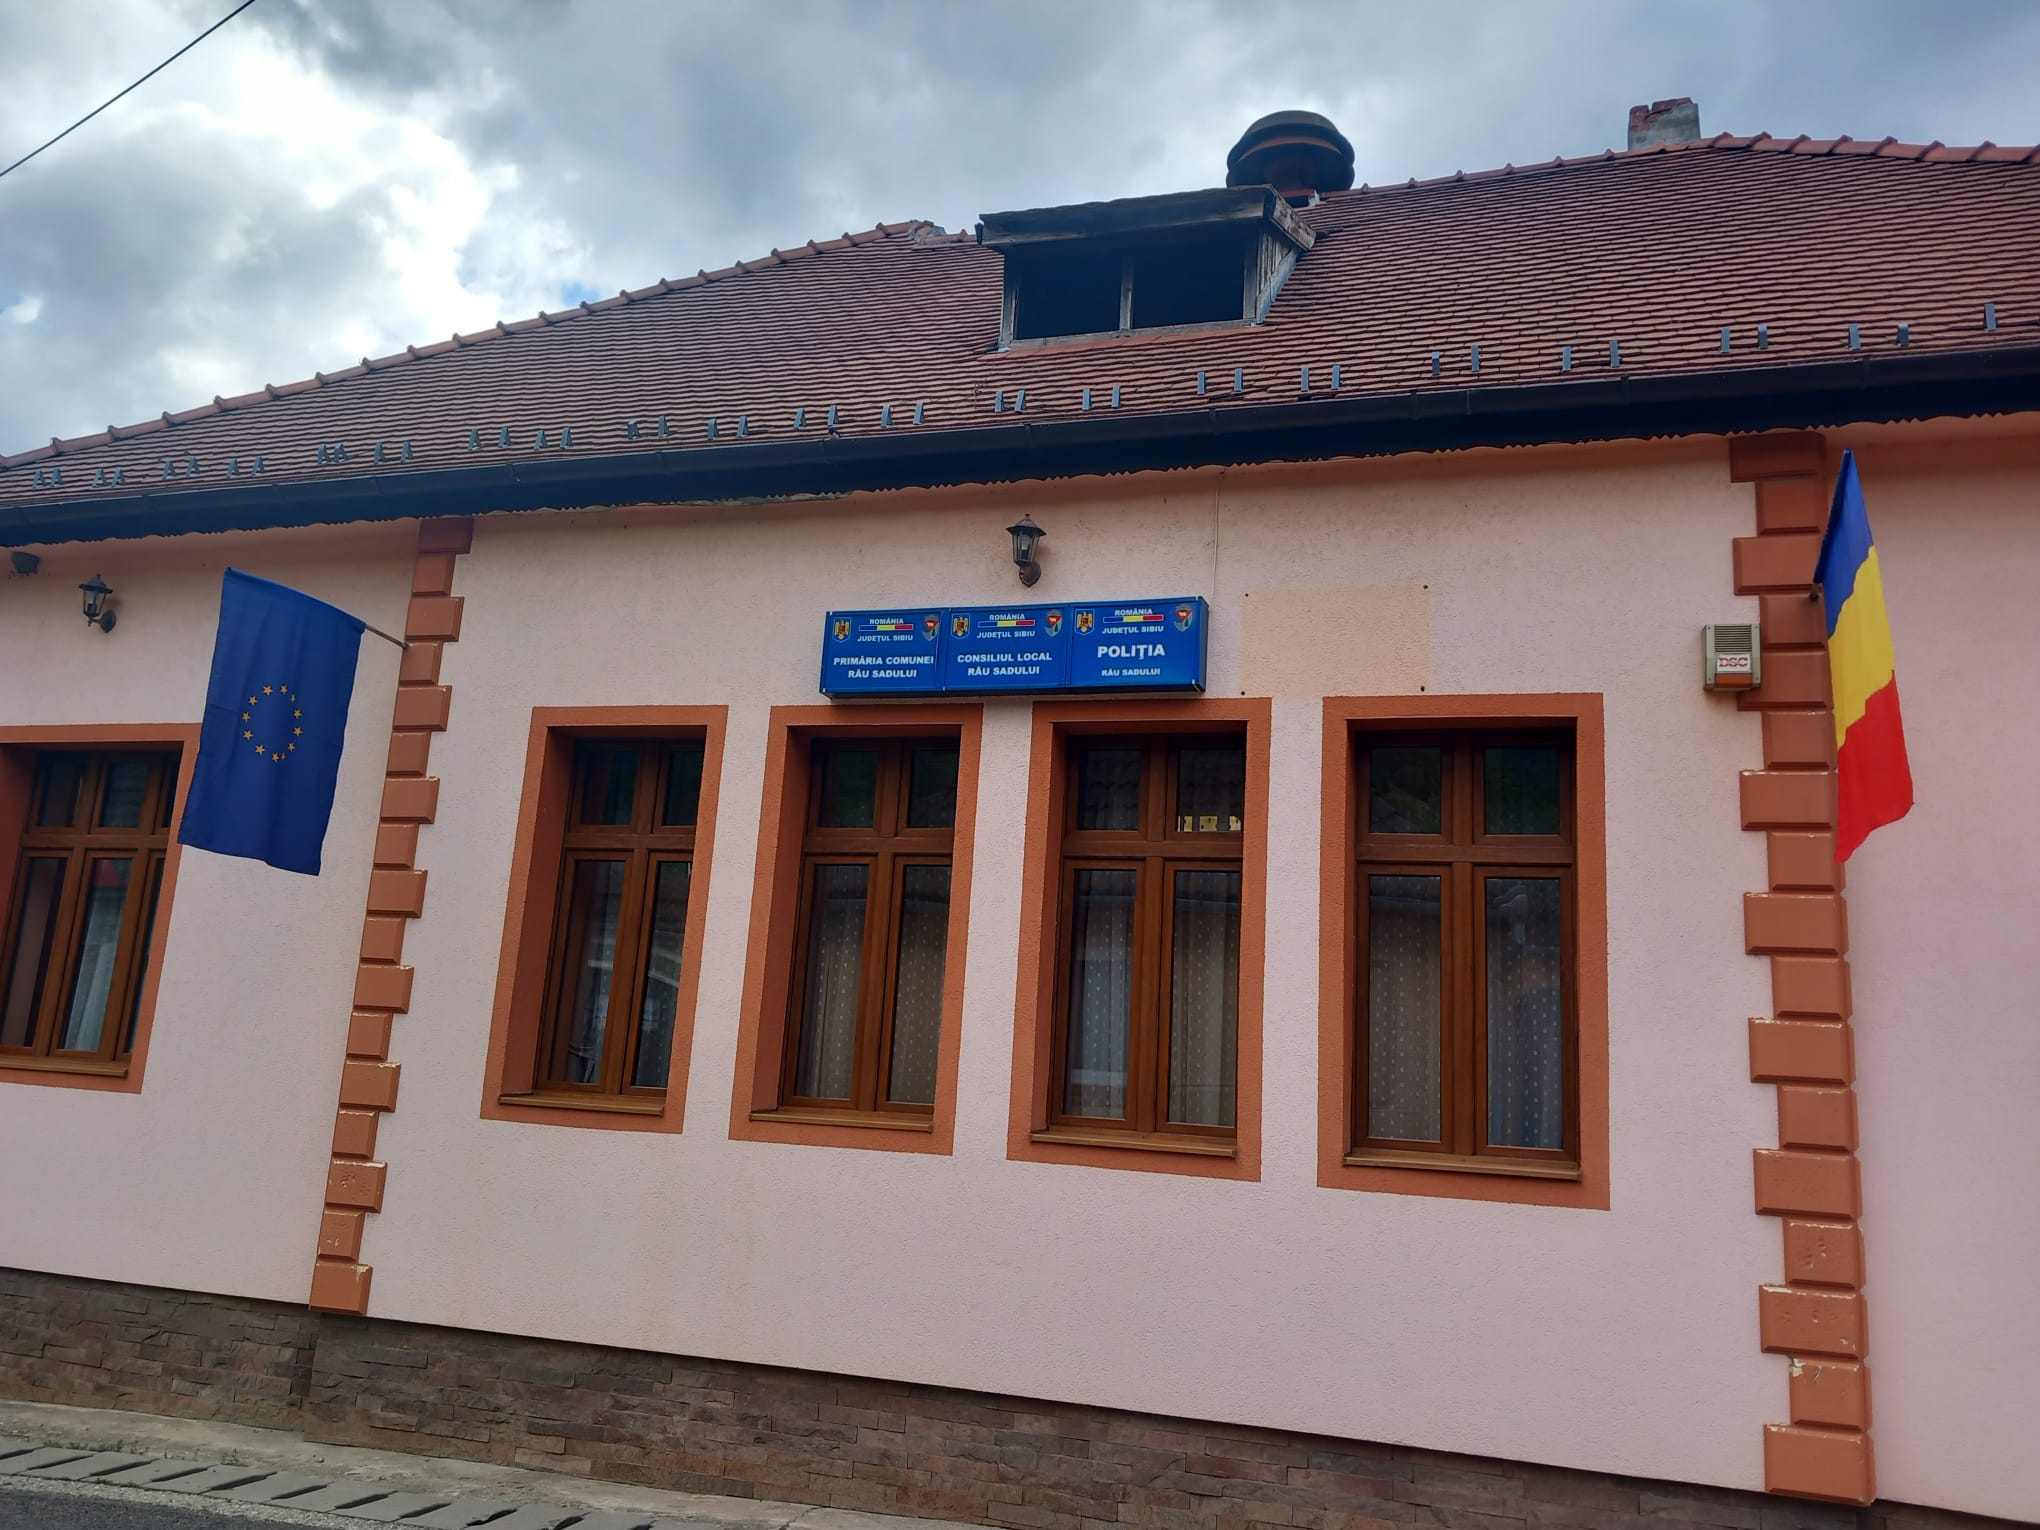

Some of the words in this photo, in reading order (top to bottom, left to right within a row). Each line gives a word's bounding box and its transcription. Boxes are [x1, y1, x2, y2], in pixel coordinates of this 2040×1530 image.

[1114, 608, 1153, 616] ROMÂNIA
[869, 617, 904, 625] ROMÂNIA
[989, 613, 1025, 621] ROMÂNIA
[1141, 625, 1164, 633] SIBIU
[1014, 630, 1035, 638] SIBIU
[833, 655, 883, 665] PRIMĂRIA
[885, 655, 934, 665] COMUNEI
[957, 653, 1015, 663] CONSILIUL
[1017, 652, 1053, 661] LOCAL
[1719, 657, 1748, 667] DSC
[848, 669, 869, 678] RÂU
[872, 669, 917, 678] SADULUI
[967, 666, 990, 676] RÂU
[992, 666, 1040, 675] SADULUI
[1101, 669, 1120, 677] RÂU
[1122, 668, 1161, 676] SADULUI
